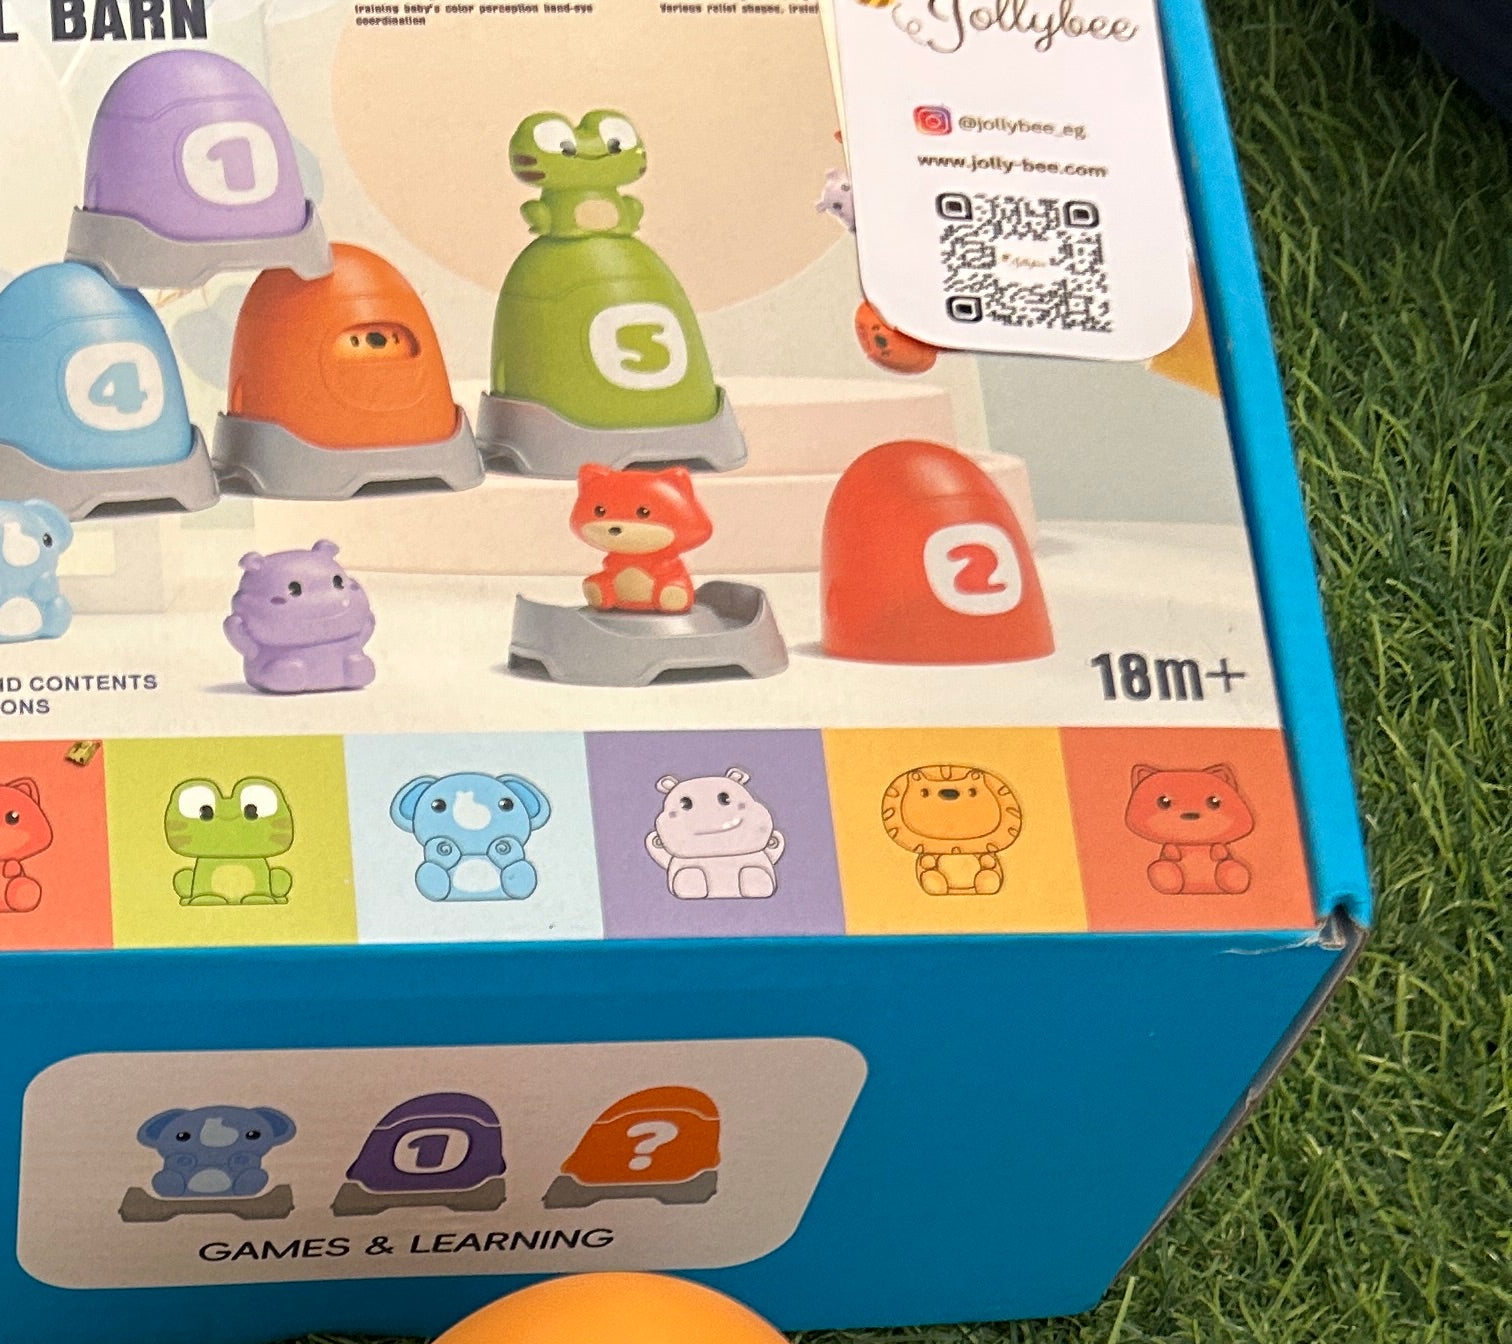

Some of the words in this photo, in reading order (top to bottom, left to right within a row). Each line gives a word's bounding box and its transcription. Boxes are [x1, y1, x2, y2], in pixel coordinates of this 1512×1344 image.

[51, 0, 208, 42] BARN
[355, 16, 426, 26] coordination
[403, 4, 440, 14] baby's
[445, 4, 474, 13] color
[479, 4, 538, 14] perception
[543, 3, 593, 13] hand-eye
[958, 115, 1087, 140] @jollybee_eg
[917, 154, 1108, 178] www.jolly-bee.com
[88, 361, 148, 415] 4
[29, 673, 159, 691] CONTENTS
[1090, 651, 1246, 701] 18m+
[197, 1237, 352, 1262] GAMES
[364, 1235, 395, 1255] &
[408, 1227, 616, 1254] LEARNING
